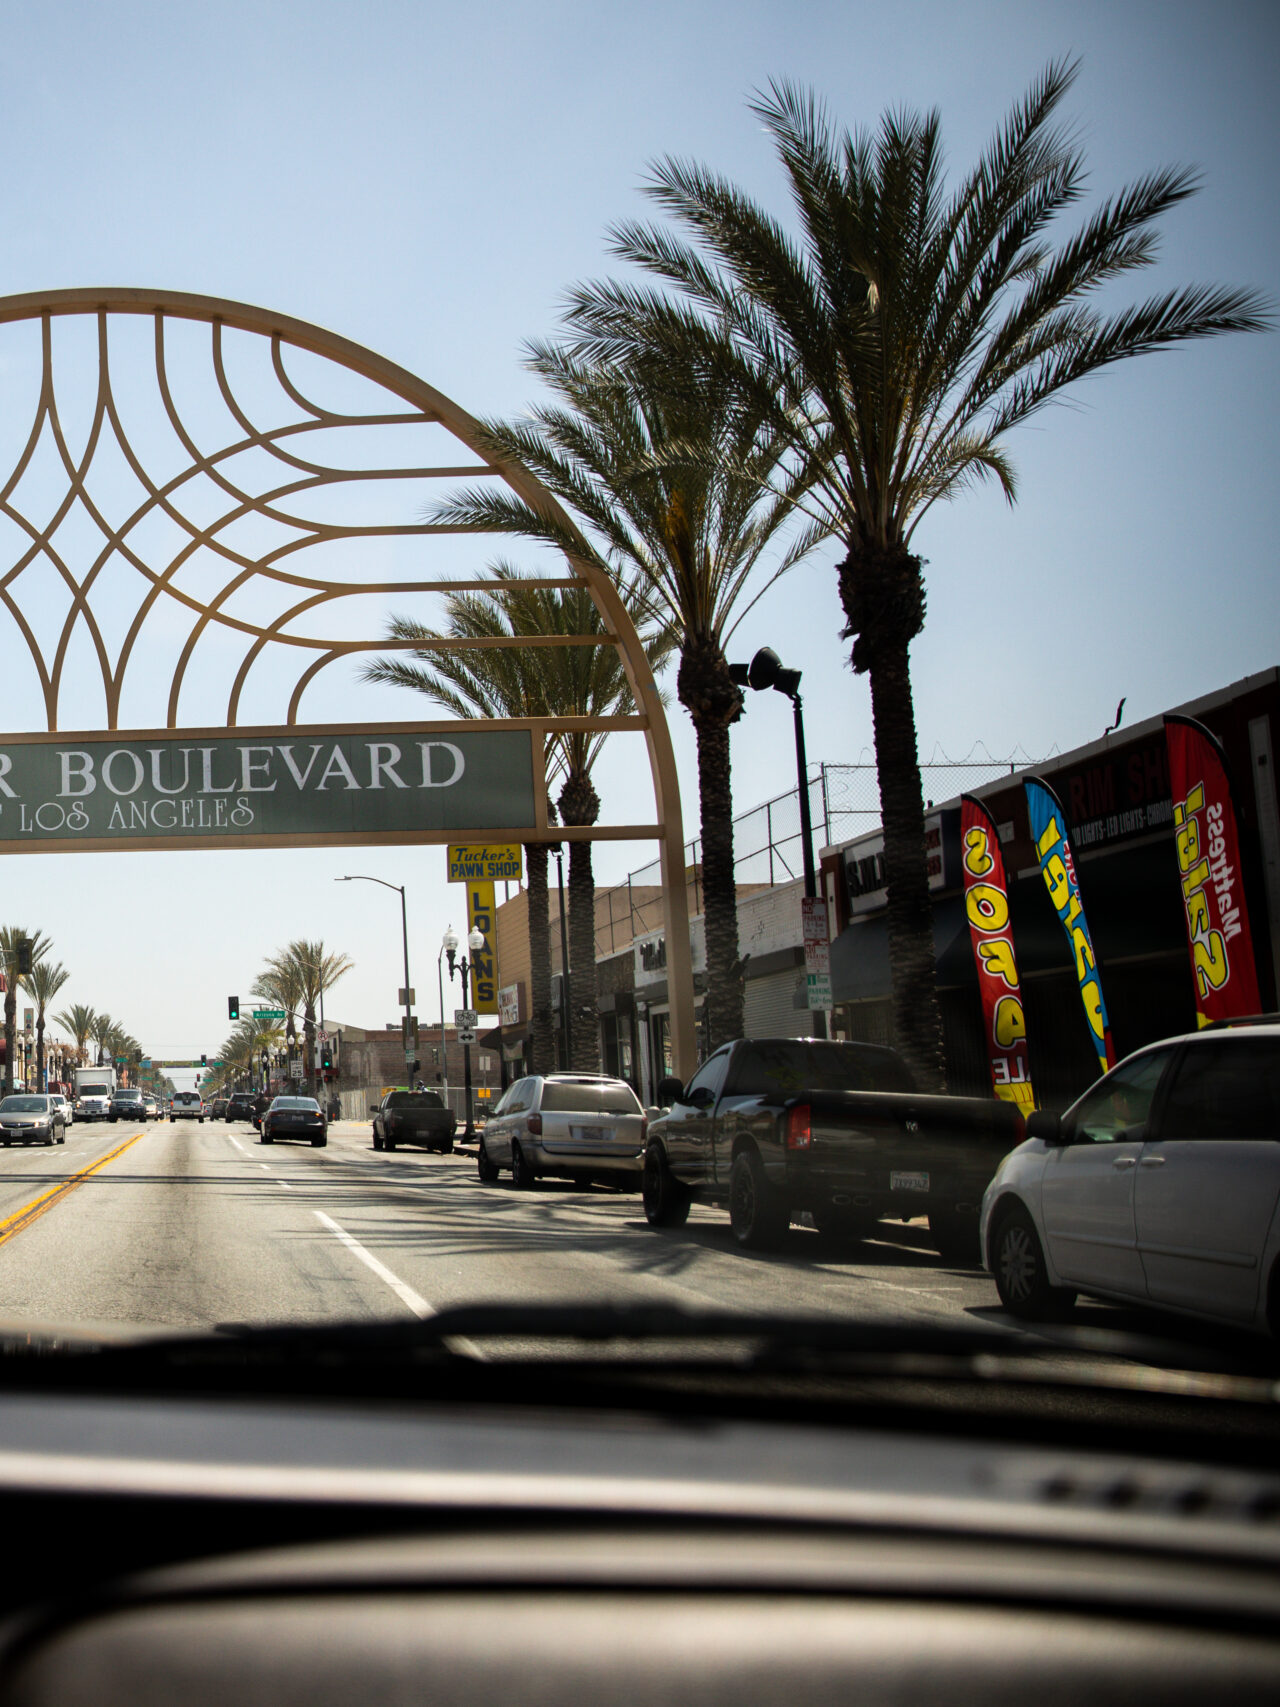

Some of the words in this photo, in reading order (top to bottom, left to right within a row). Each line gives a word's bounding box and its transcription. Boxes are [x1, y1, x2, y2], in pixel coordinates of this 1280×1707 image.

[56, 742, 466, 797] BOULEVARD
[1127, 746, 1171, 805] SH
[19, 801, 89, 832] LOS
[107, 797, 255, 830] ANGELES
[451, 863, 484, 877] PAWN
[487, 862, 520, 877] SHOP
[455, 847, 515, 862] Tucker's
